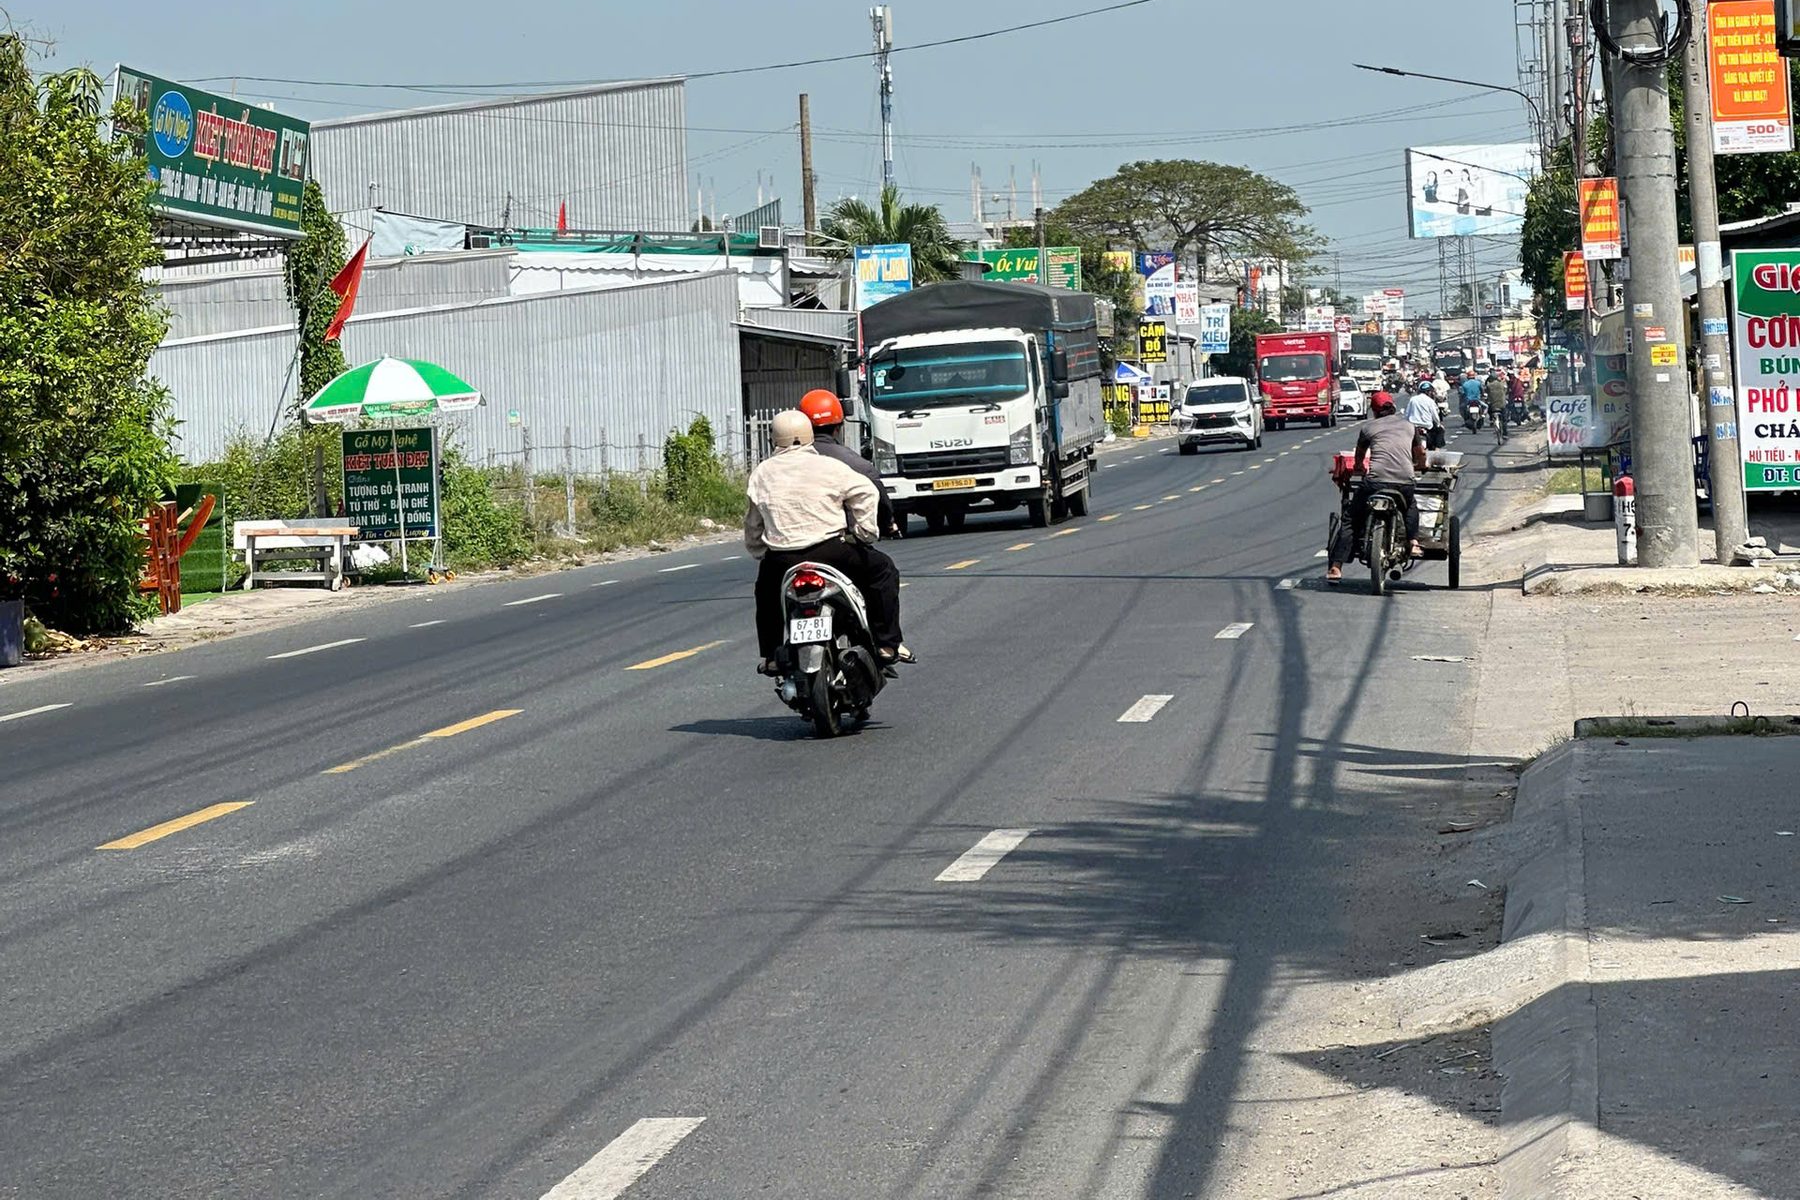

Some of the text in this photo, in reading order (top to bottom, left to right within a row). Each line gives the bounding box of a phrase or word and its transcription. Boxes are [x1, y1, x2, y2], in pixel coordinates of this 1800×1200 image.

[1747, 125, 1775, 134] 500
[996, 252, 1014, 272] Ốc
[1016, 257, 1038, 272] Vui
[1206, 315, 1225, 328] TRÍ
[1748, 379, 1789, 413] PHỞ
[1550, 399, 1587, 416] Café
[354, 435, 370, 448] Gỗ
[371, 435, 388, 449] Mỹ
[930, 439, 973, 449] ISUZU
[1749, 446, 1762, 462] HỦ
[345, 451, 372, 474] KIỆT
[406, 450, 429, 470] ĐẠT
[1763, 468, 1789, 482] ĐT:
[349, 484, 378, 498] TƯỢNG
[381, 481, 392, 495] GỖ
[400, 482, 429, 494] TRANH
[350, 499, 360, 512] TỦ
[363, 498, 380, 511] THỜ
[411, 494, 429, 508] GHẾ
[350, 514, 368, 526] BÀN
[370, 512, 387, 525] THỜ
[365, 530, 377, 539] Tín
